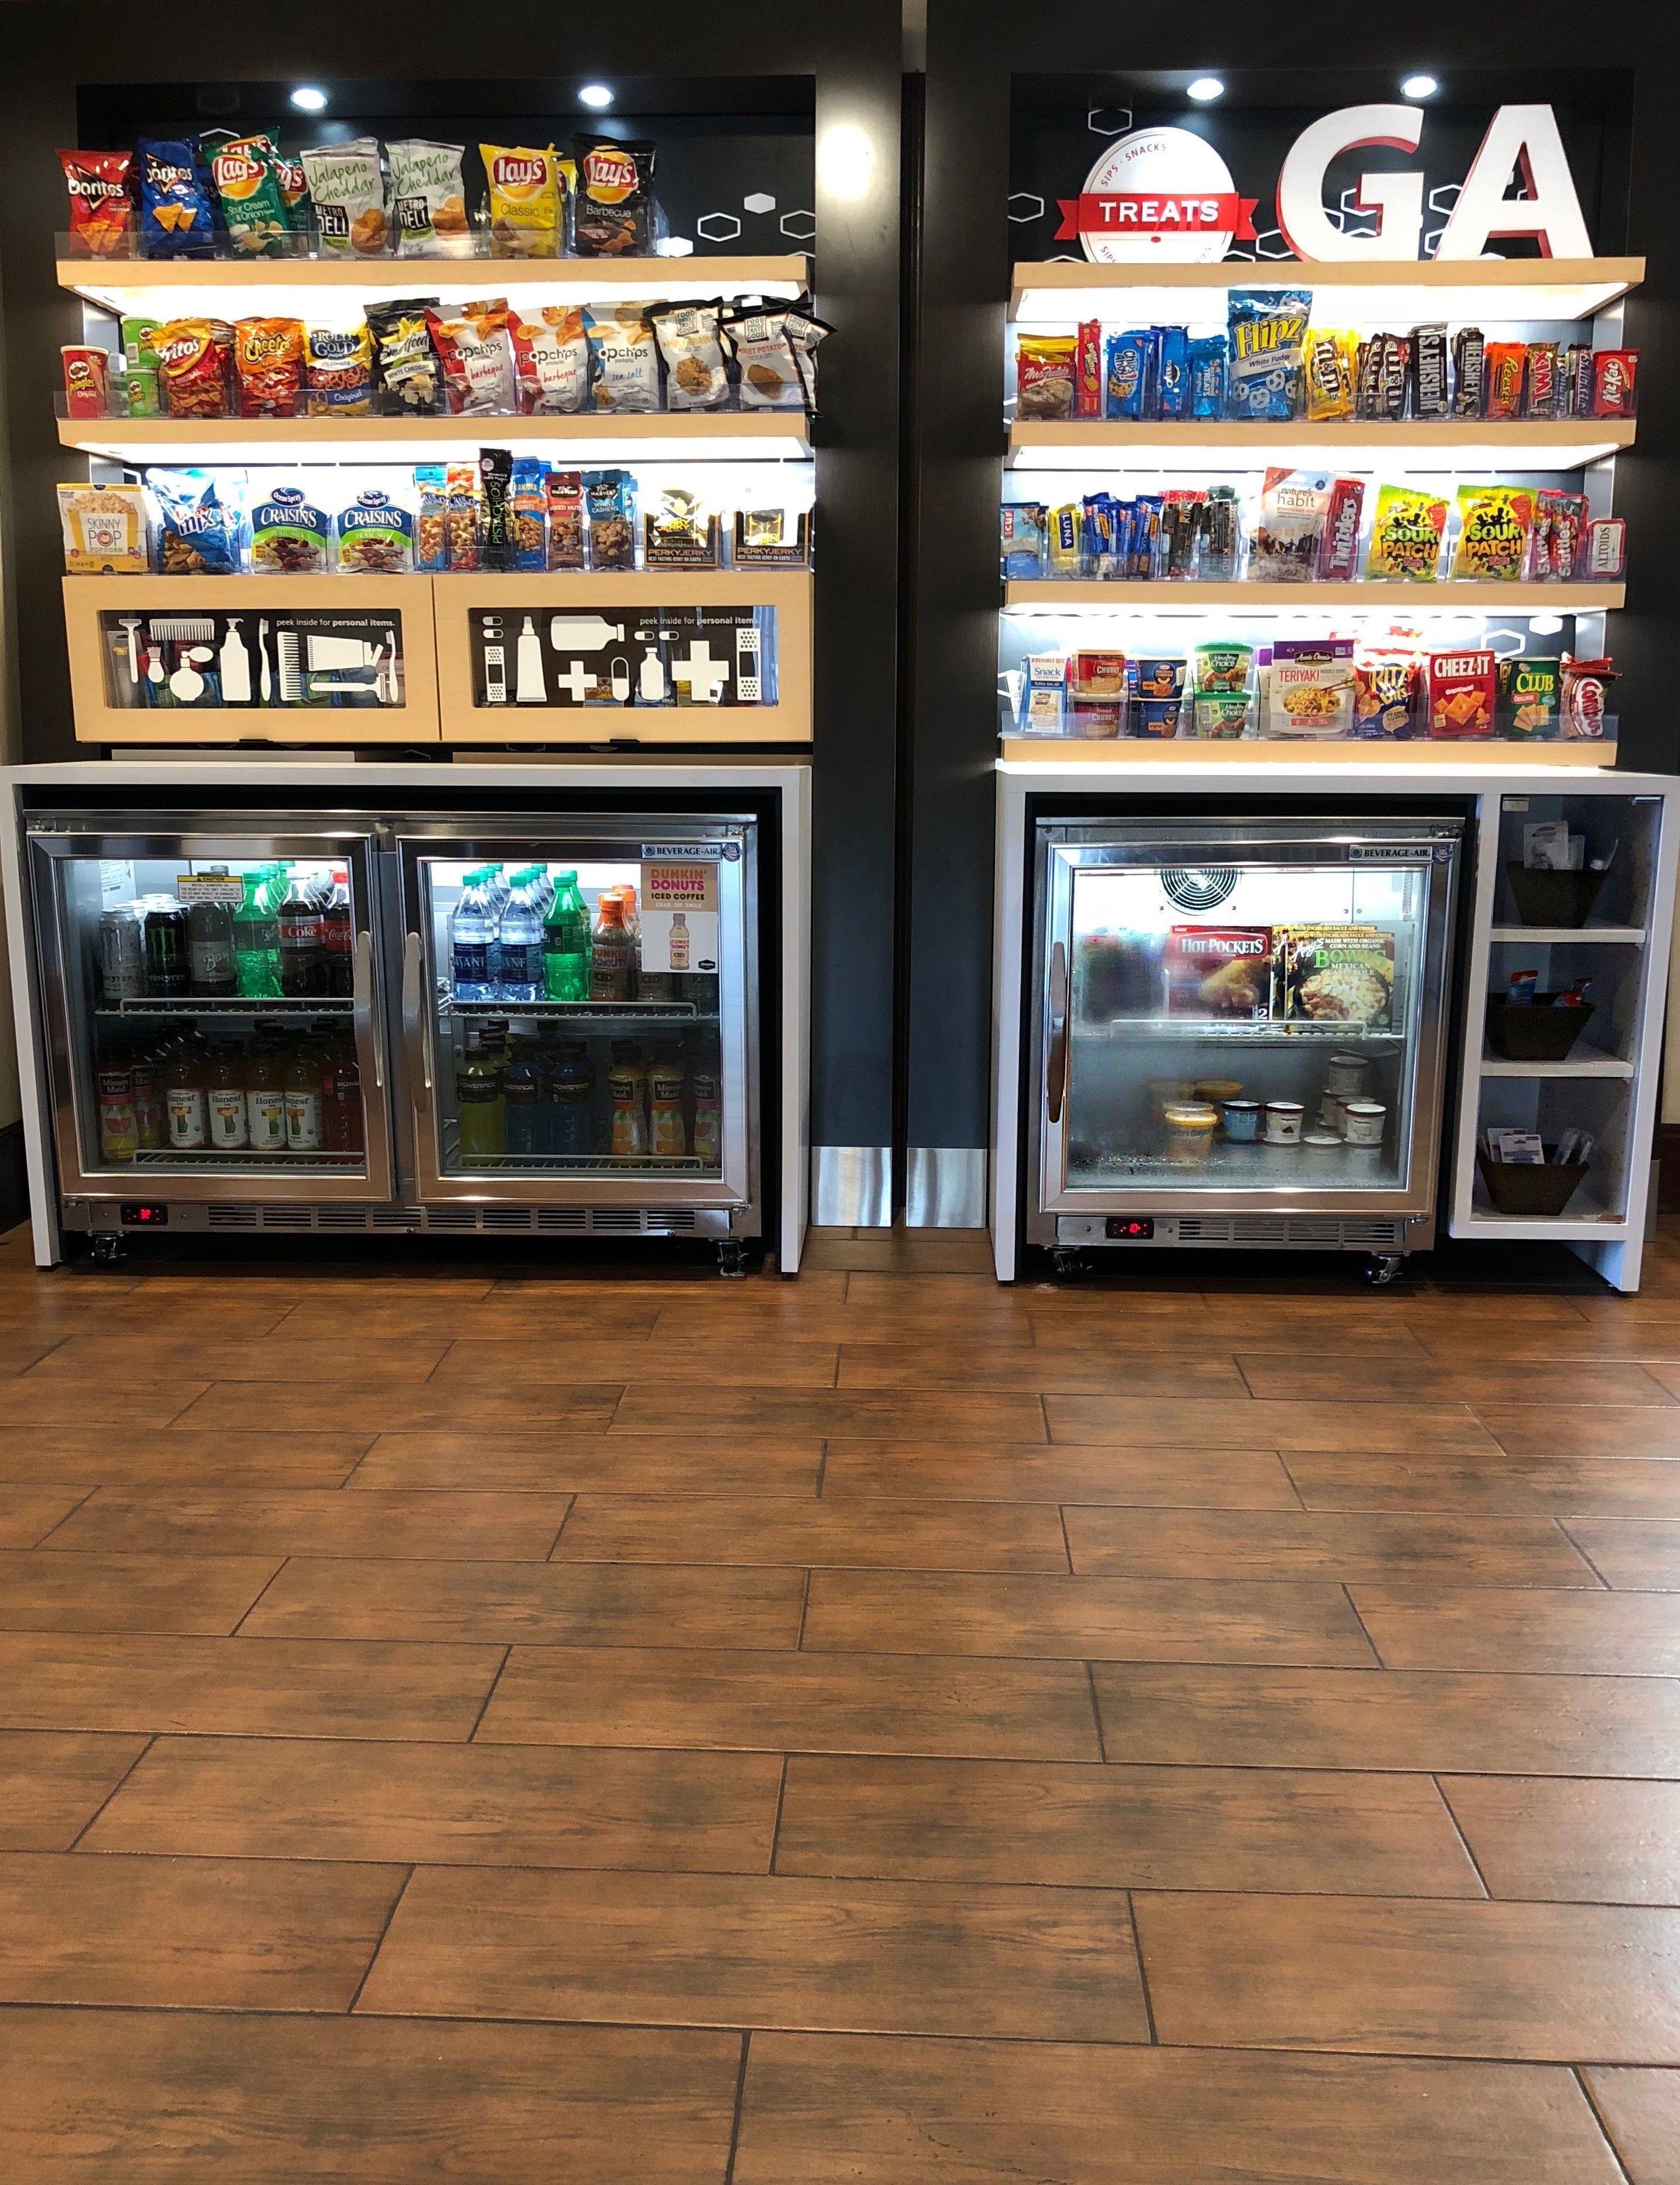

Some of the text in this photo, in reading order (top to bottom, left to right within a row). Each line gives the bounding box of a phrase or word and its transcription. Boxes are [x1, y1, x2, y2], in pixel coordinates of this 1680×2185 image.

[498, 159, 543, 184] Lay's
[584, 157, 633, 187] Lay's
[1101, 143, 1167, 187] SIPS SNACKS
[67, 178, 124, 198] Doritos
[314, 177, 375, 203] Cheddar
[397, 168, 454, 196] Cheddar
[398, 199, 424, 212] METRO
[500, 203, 540, 217] Classic
[586, 204, 632, 219] Barbecue
[1099, 200, 1219, 223] TREATS
[400, 210, 427, 229] DELI
[315, 340, 355, 356] GOLD
[1235, 317, 1303, 361] Flipz
[447, 341, 503, 362] popchips
[520, 347, 577, 367] popchips
[1249, 353, 1291, 368] White Fudge
[471, 363, 505, 381] barbeque
[1124, 350, 1137, 376] Chips
[387, 369, 403, 380] WHITE
[543, 368, 577, 384] barbeque
[627, 367, 643, 380] salt
[1419, 335, 1440, 410] HERSHEY'S
[1464, 342, 1482, 404] HERSHEY'S
[1500, 355, 1519, 406] Reese's
[1530, 352, 1553, 408] TWIX
[1203, 367, 1211, 397] TREATS
[335, 391, 363, 404] Original
[273, 491, 301, 504] Ocean Spray
[1277, 493, 1316, 507] habit
[1280, 488, 1313, 497] nature's
[261, 507, 317, 528] CRAISINS
[345, 510, 403, 529] CRAISINS
[490, 480, 503, 544] PISTACHIOS
[1093, 504, 1101, 534] PROTEIN
[88, 518, 120, 530] SKINNY
[1062, 514, 1073, 546] LUNA
[1329, 497, 1358, 569] Twizzlers
[1468, 522, 1522, 540] SOUR
[88, 530, 122, 546] POP
[1383, 524, 1437, 543] SOUR
[1381, 541, 1439, 559] PATCH
[1466, 540, 1522, 558] PATCH
[1536, 519, 1551, 574] Skittles
[1556, 521, 1572, 577] Skittles
[1597, 526, 1610, 568] ALTOIDS
[277, 619, 294, 627] peek
[333, 618, 368, 628] personal
[370, 618, 396, 626] items.
[640, 616, 758, 626] peek inside for personal item
[1034, 667, 1061, 676] Snack
[1096, 665, 1120, 675] CHUNKY
[1211, 659, 1236, 667] Choice
[1279, 669, 1320, 683] TERIYAKI
[1371, 666, 1408, 693] RITZ
[1516, 673, 1555, 693] CLUB
[1581, 681, 1603, 735] Combos
[657, 847, 719, 855] BEVERAGE-AIR
[1364, 849, 1429, 857] BEVERAGE-AIR
[650, 869, 707, 880] DUNKIN'
[651, 880, 705, 891] DONUTS
[288, 925, 317, 938] Coke
[328, 929, 352, 941] Coca-C
[1208, 938, 1264, 955] POCKETS
[1292, 938, 1324, 963] Amy's
[1313, 949, 1386, 969] BOWLS
[595, 973, 612, 981] ICED
[1258, 1007, 1268, 1020] 2
[212, 1095, 241, 1103] Honest
